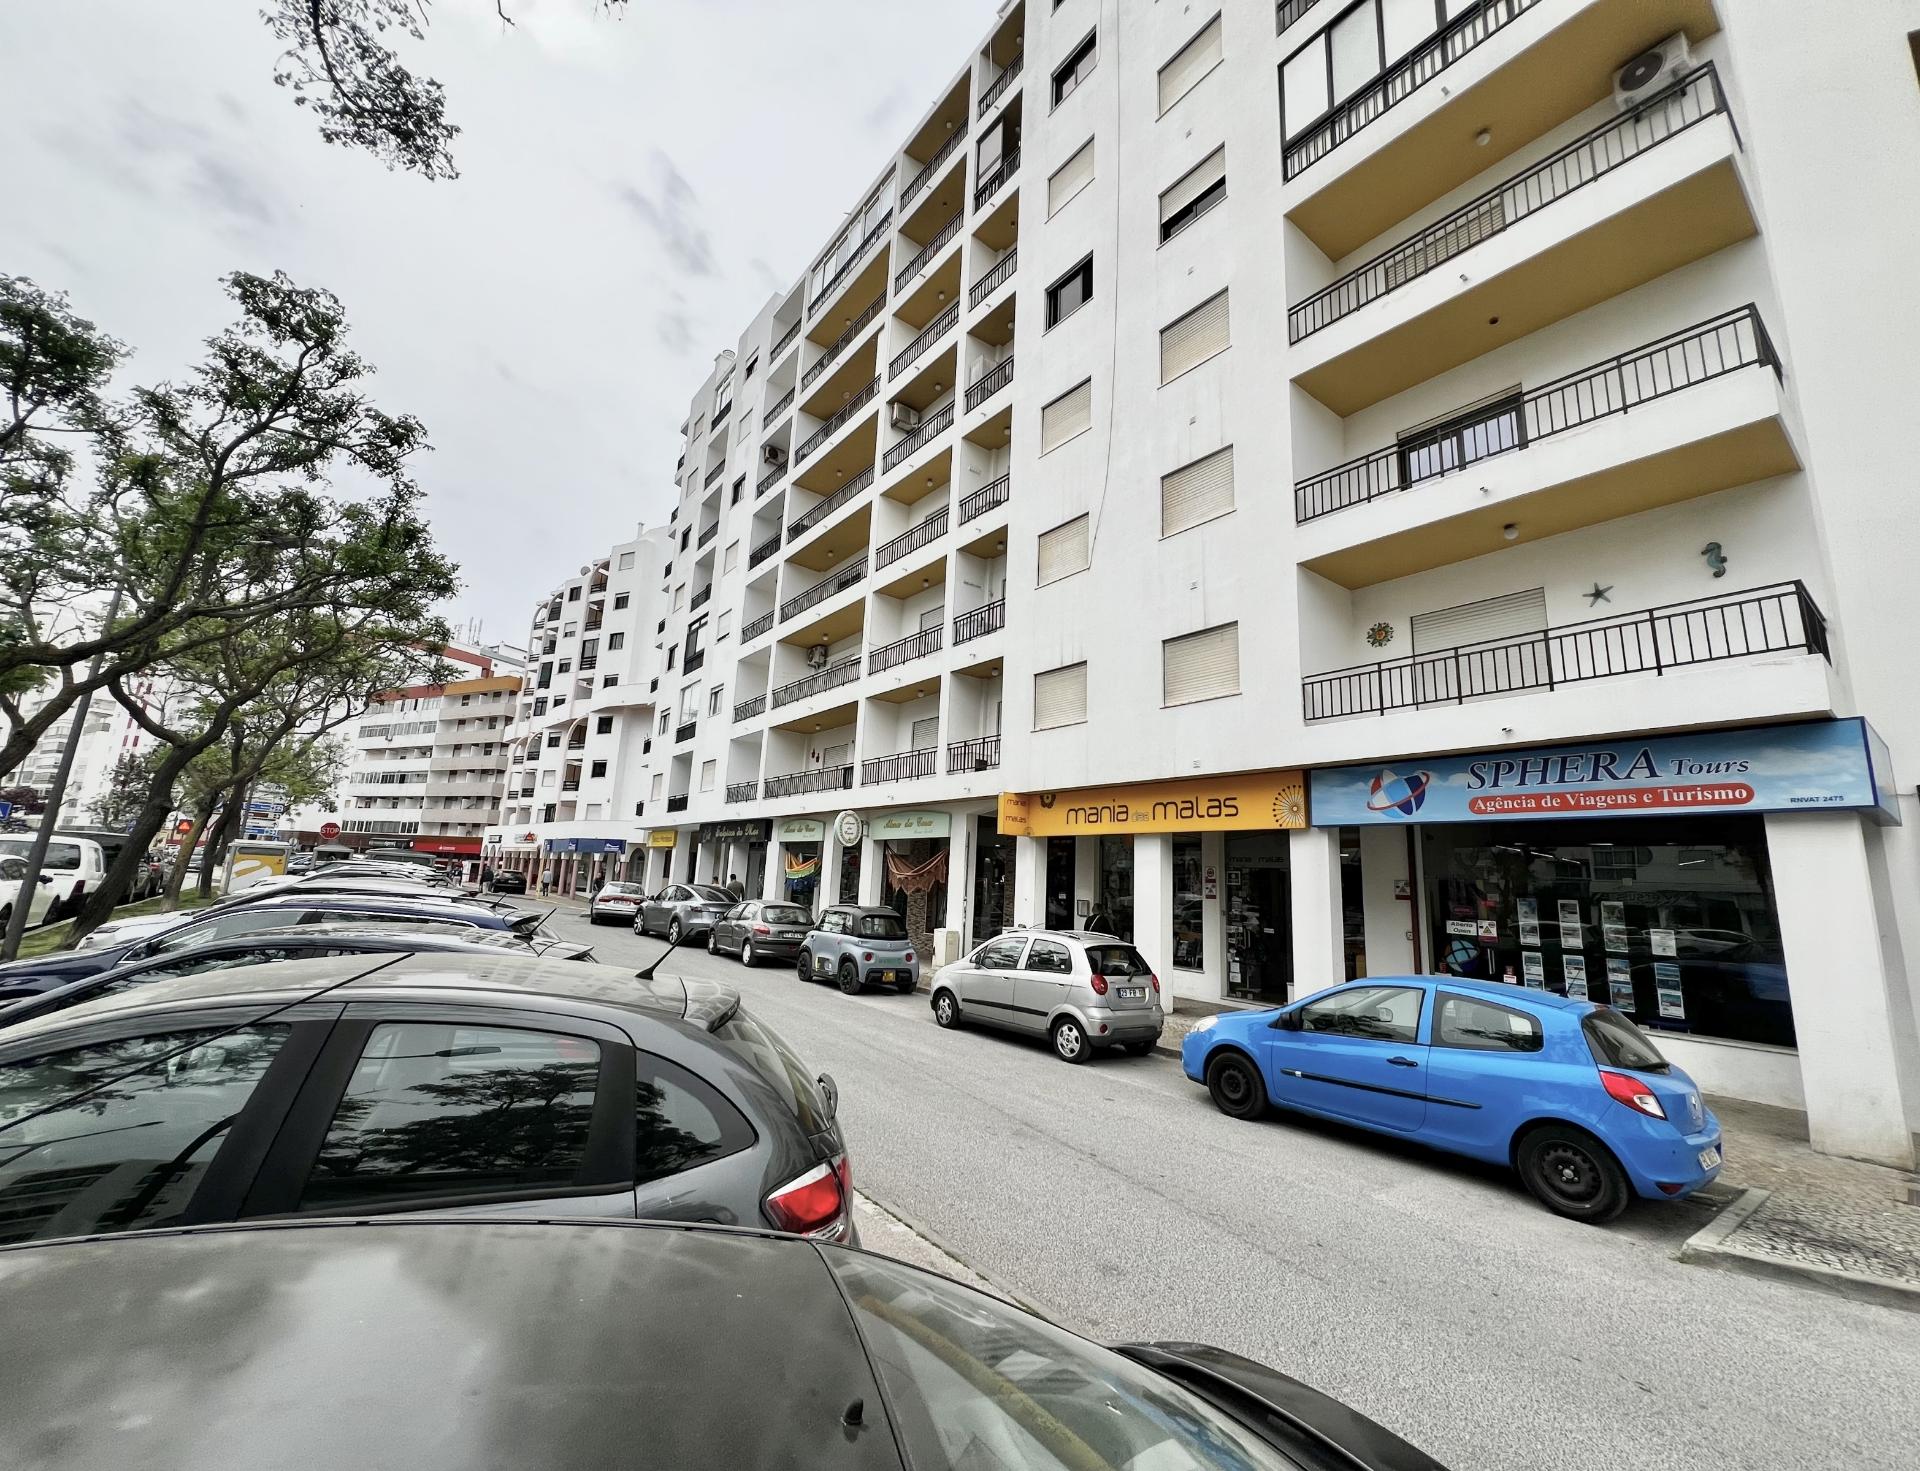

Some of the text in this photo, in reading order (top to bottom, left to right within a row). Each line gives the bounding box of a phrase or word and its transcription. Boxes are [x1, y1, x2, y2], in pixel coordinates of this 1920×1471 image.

[1467, 748, 1749, 790] SPHERA Tours
[1066, 799, 1129, 825] mania
[1152, 796, 1239, 821] malas
[1474, 787, 1747, 814] Agência de Viagens e Turismo
